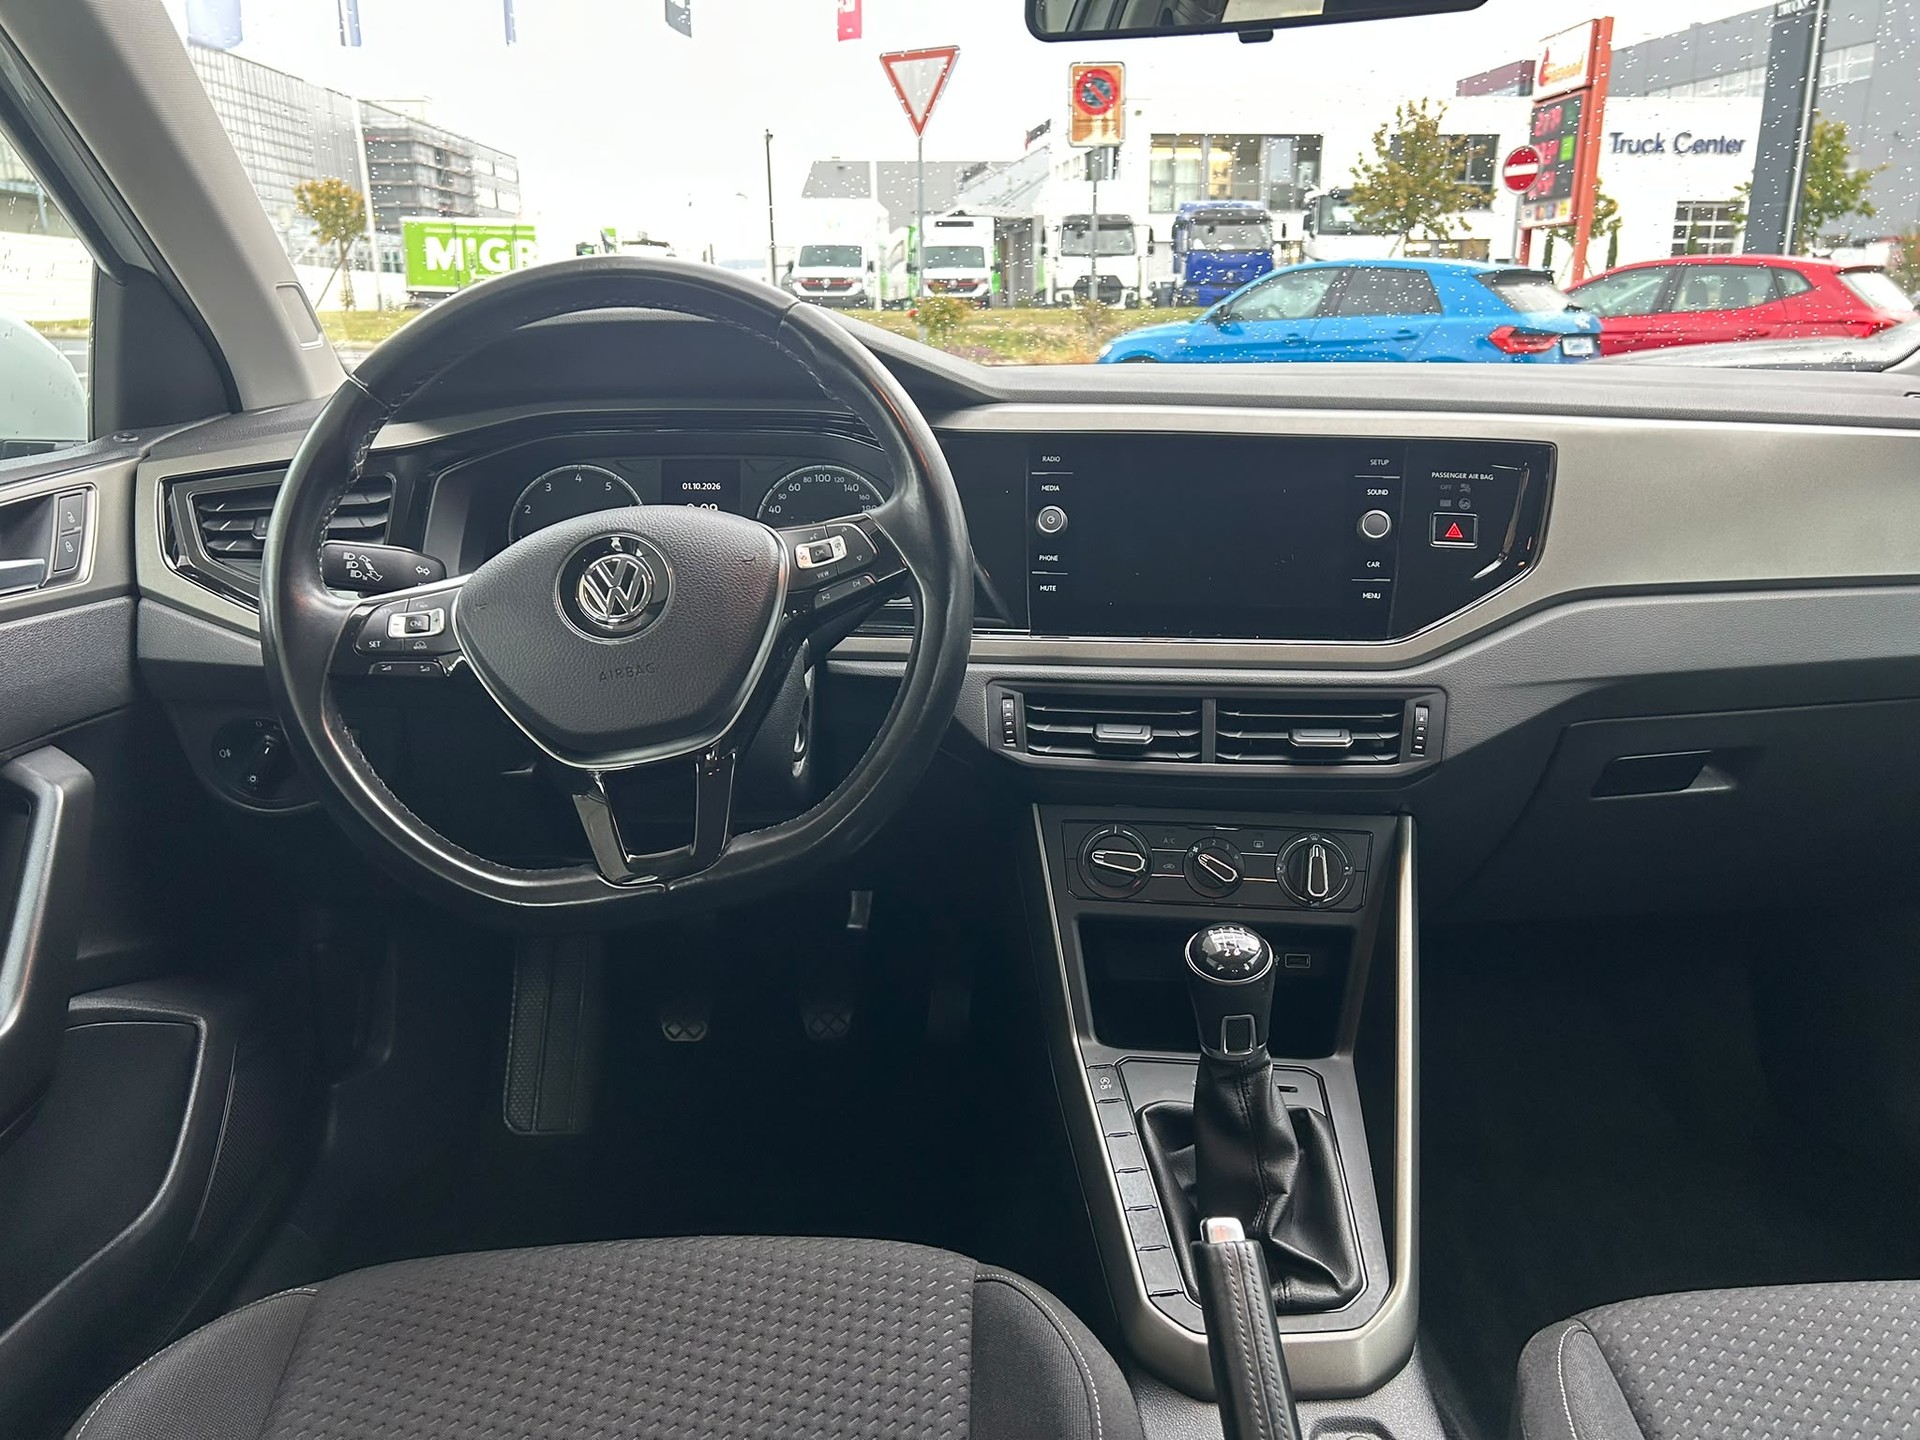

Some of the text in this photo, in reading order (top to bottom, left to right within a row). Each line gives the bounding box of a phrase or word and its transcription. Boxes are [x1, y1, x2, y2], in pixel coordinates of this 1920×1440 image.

[1609, 131, 1746, 154] Truck Center
[575, 474, 582, 482] 4
[814, 474, 831, 482] 100
[545, 483, 552, 492] 3
[605, 482, 612, 491] 5
[682, 482, 721, 490] 01.10.2026
[788, 483, 801, 491] 60
[844, 484, 859, 492] 140
[524, 505, 531, 514] 2
[768, 505, 781, 513] 40
[600, 663, 656, 681] AIRBAG
[1224, 948, 1231, 957] 2
